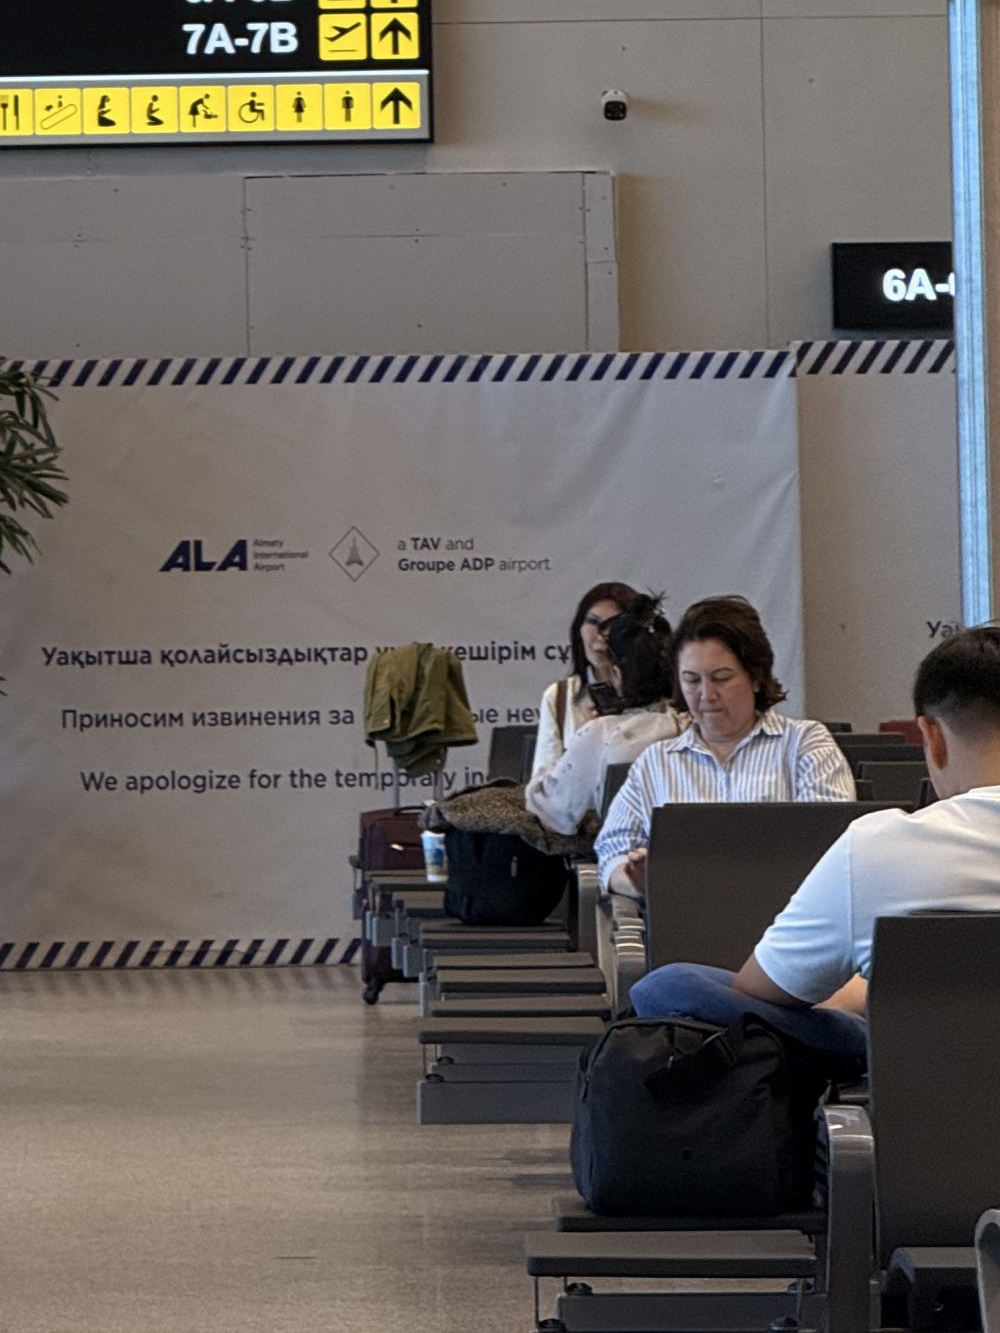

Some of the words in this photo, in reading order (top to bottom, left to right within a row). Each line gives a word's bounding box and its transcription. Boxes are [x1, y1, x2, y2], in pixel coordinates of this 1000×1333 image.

[182, 21, 298, 55] 7A-7B
[882, 268, 955, 301] 6A-
[159, 539, 248, 572] ALA
[398, 540, 406, 550] a
[411, 538, 441, 550] TAV
[446, 538, 474, 550] and
[398, 558, 455, 573] Groupe
[460, 558, 495, 571] ADP
[499, 557, 551, 572] airport
[42, 647, 152, 668] Уақытша
[160, 643, 368, 667] қолайсыздықтар
[62, 710, 184, 731] Приносим
[192, 710, 320, 726] извинения
[328, 709, 355, 725] за
[80, 771, 118, 791] We
[126, 771, 240, 793] apologize
[248, 769, 281, 788] for
[289, 768, 326, 788] the
